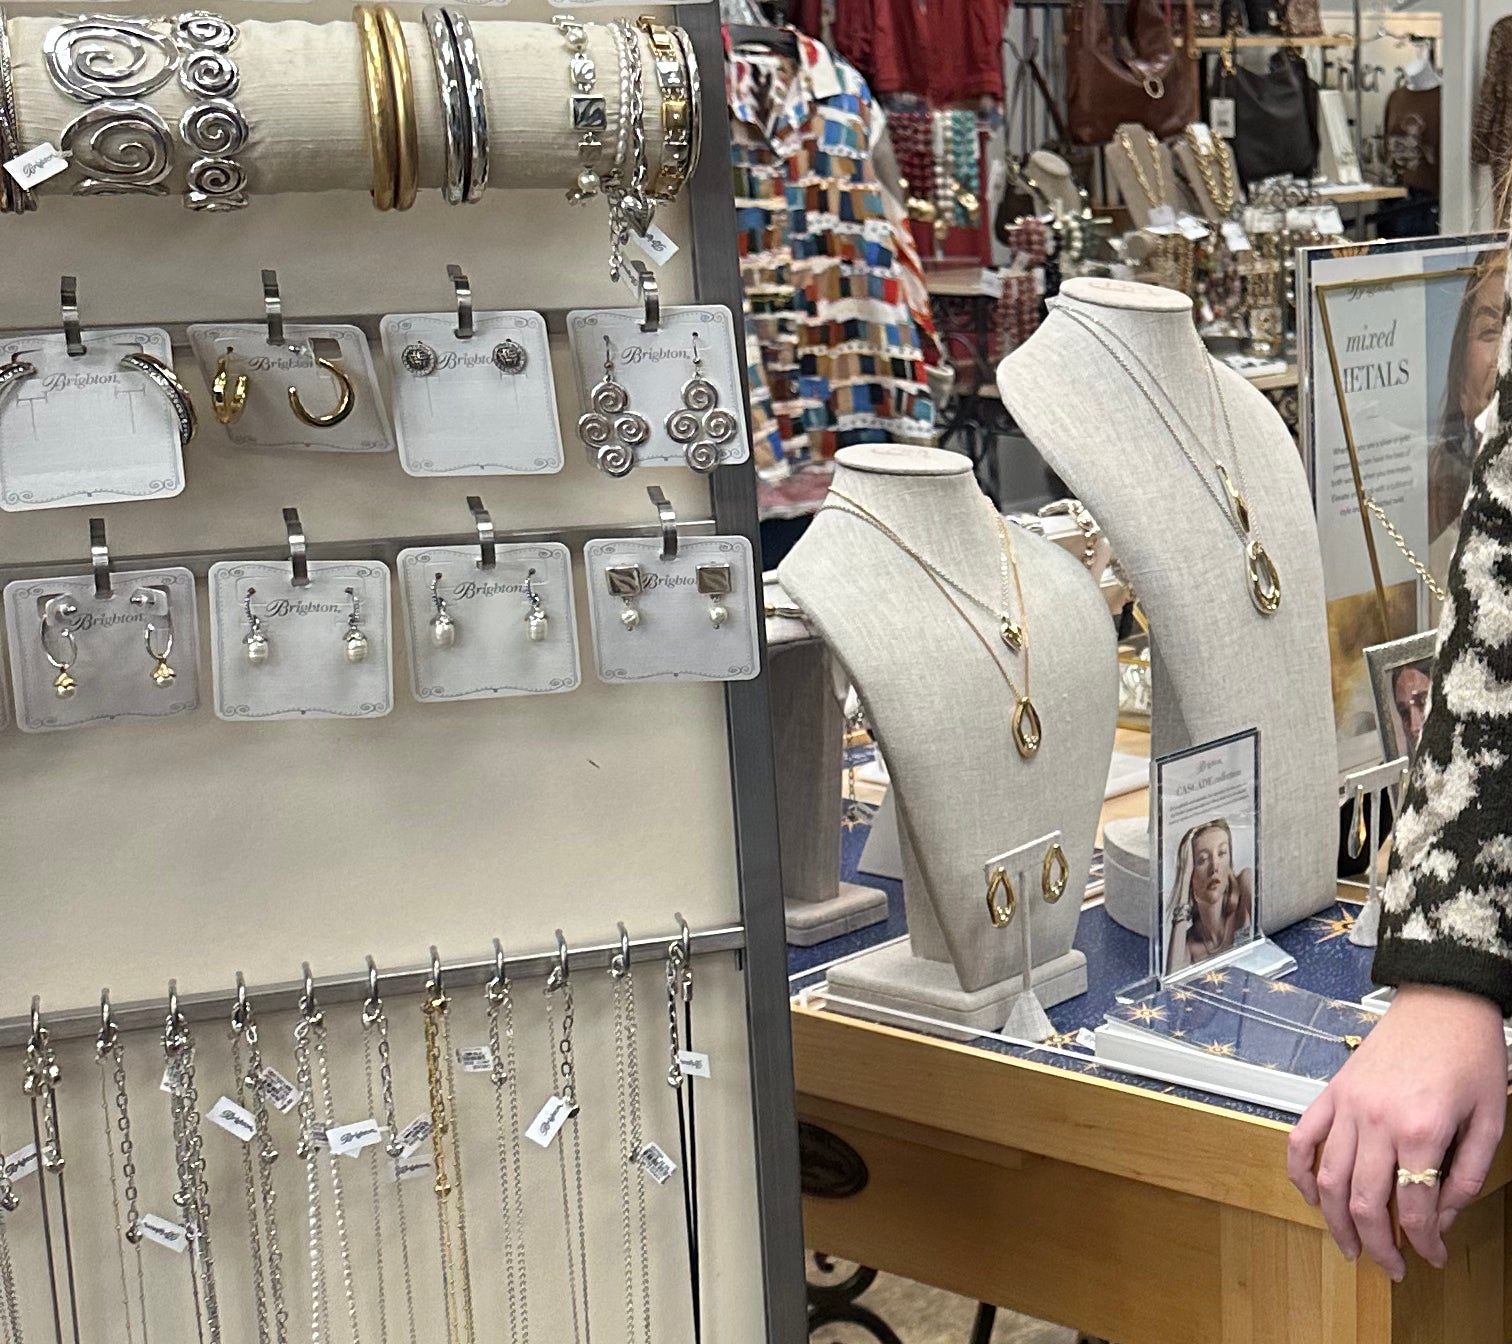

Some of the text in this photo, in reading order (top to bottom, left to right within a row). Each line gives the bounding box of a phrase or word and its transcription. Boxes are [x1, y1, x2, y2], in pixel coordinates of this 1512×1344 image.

[1346, 319, 1397, 352] mixed
[436, 351, 494, 370] Brighto
[621, 346, 689, 366] Brighton
[42, 371, 119, 392] Brighton
[453, 581, 526, 601] Brighton
[643, 573, 698, 590] Brighto
[265, 598, 341, 618] Brighton
[68, 612, 145, 632] Brighton
